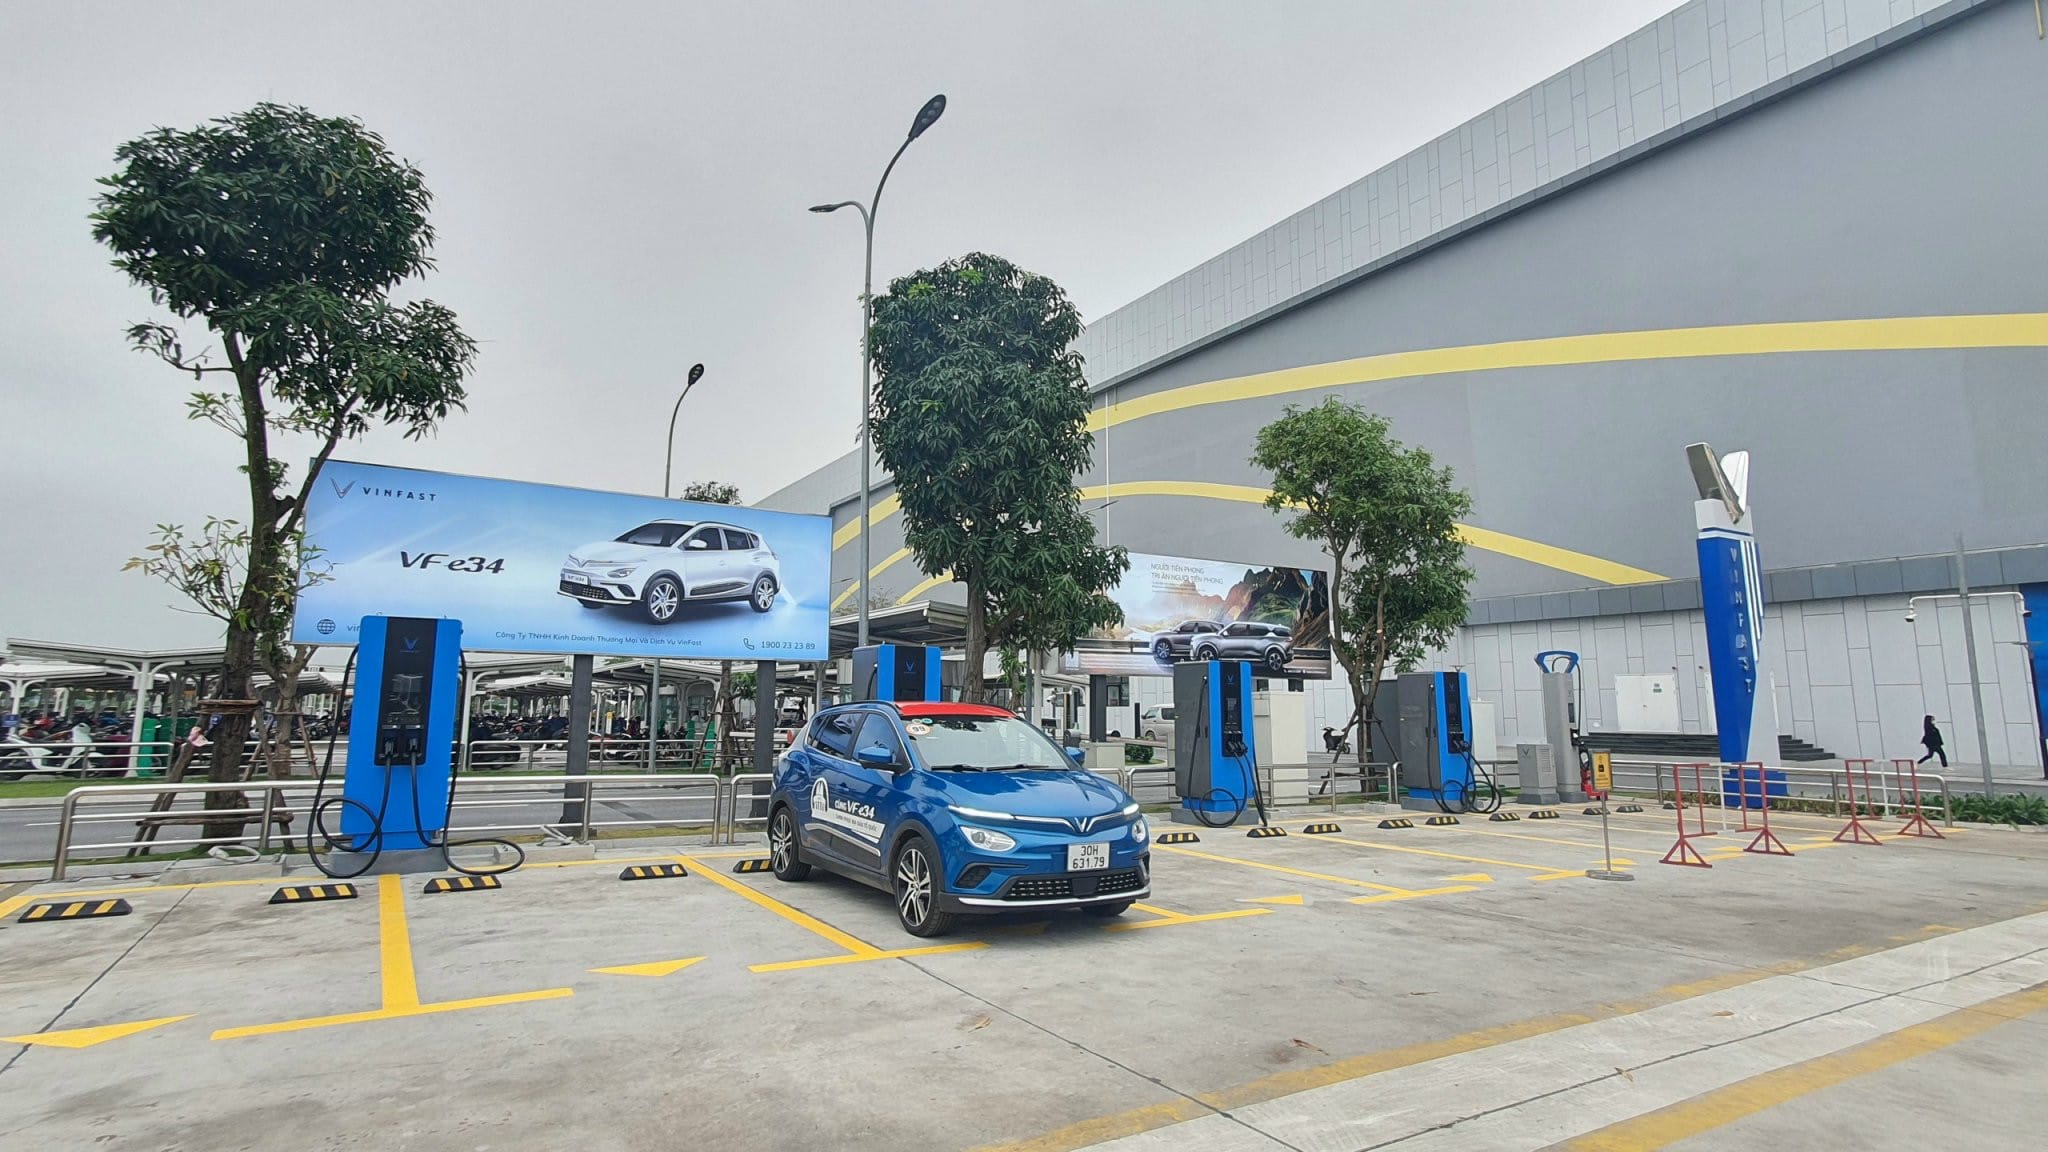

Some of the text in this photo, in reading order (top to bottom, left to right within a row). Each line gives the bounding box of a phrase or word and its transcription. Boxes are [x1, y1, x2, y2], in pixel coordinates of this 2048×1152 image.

[362, 486, 437, 501] VINFAST
[401, 551, 505, 574] VF e34
[495, 631, 515, 640] Công
[518, 632, 526, 640] Ty
[528, 632, 551, 640] TNHH
[553, 633, 569, 641] Kinh
[677, 639, 702, 647] VinFast
[761, 641, 781, 649] 1900
[794, 642, 804, 650] 23
[1080, 845, 1099, 856] 30H
[1072, 856, 1105, 869] 631.79
